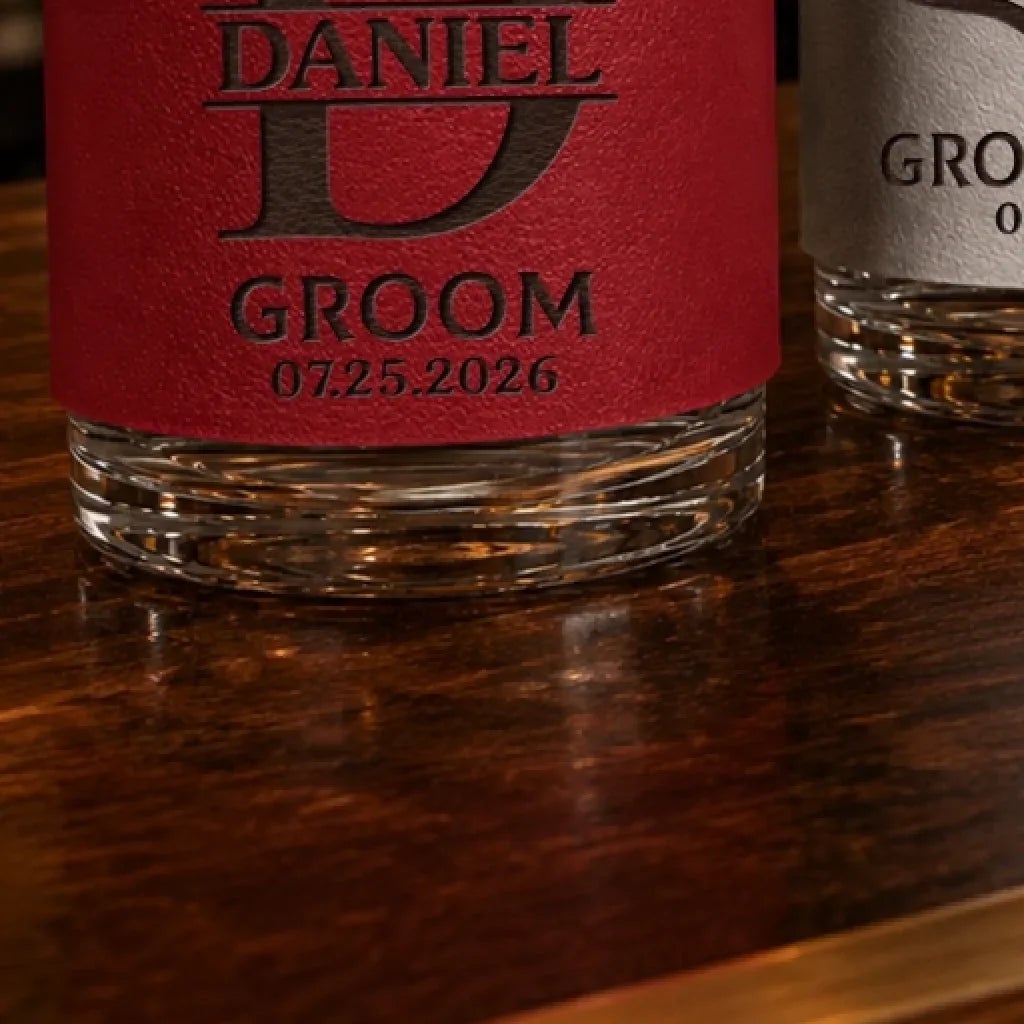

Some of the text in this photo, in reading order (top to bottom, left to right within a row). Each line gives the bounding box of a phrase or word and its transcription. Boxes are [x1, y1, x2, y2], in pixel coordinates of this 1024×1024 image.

[218, 14, 603, 92] DANIEL
[229, 270, 599, 345] GROOM
[270, 355, 560, 399] 07.25.2026
